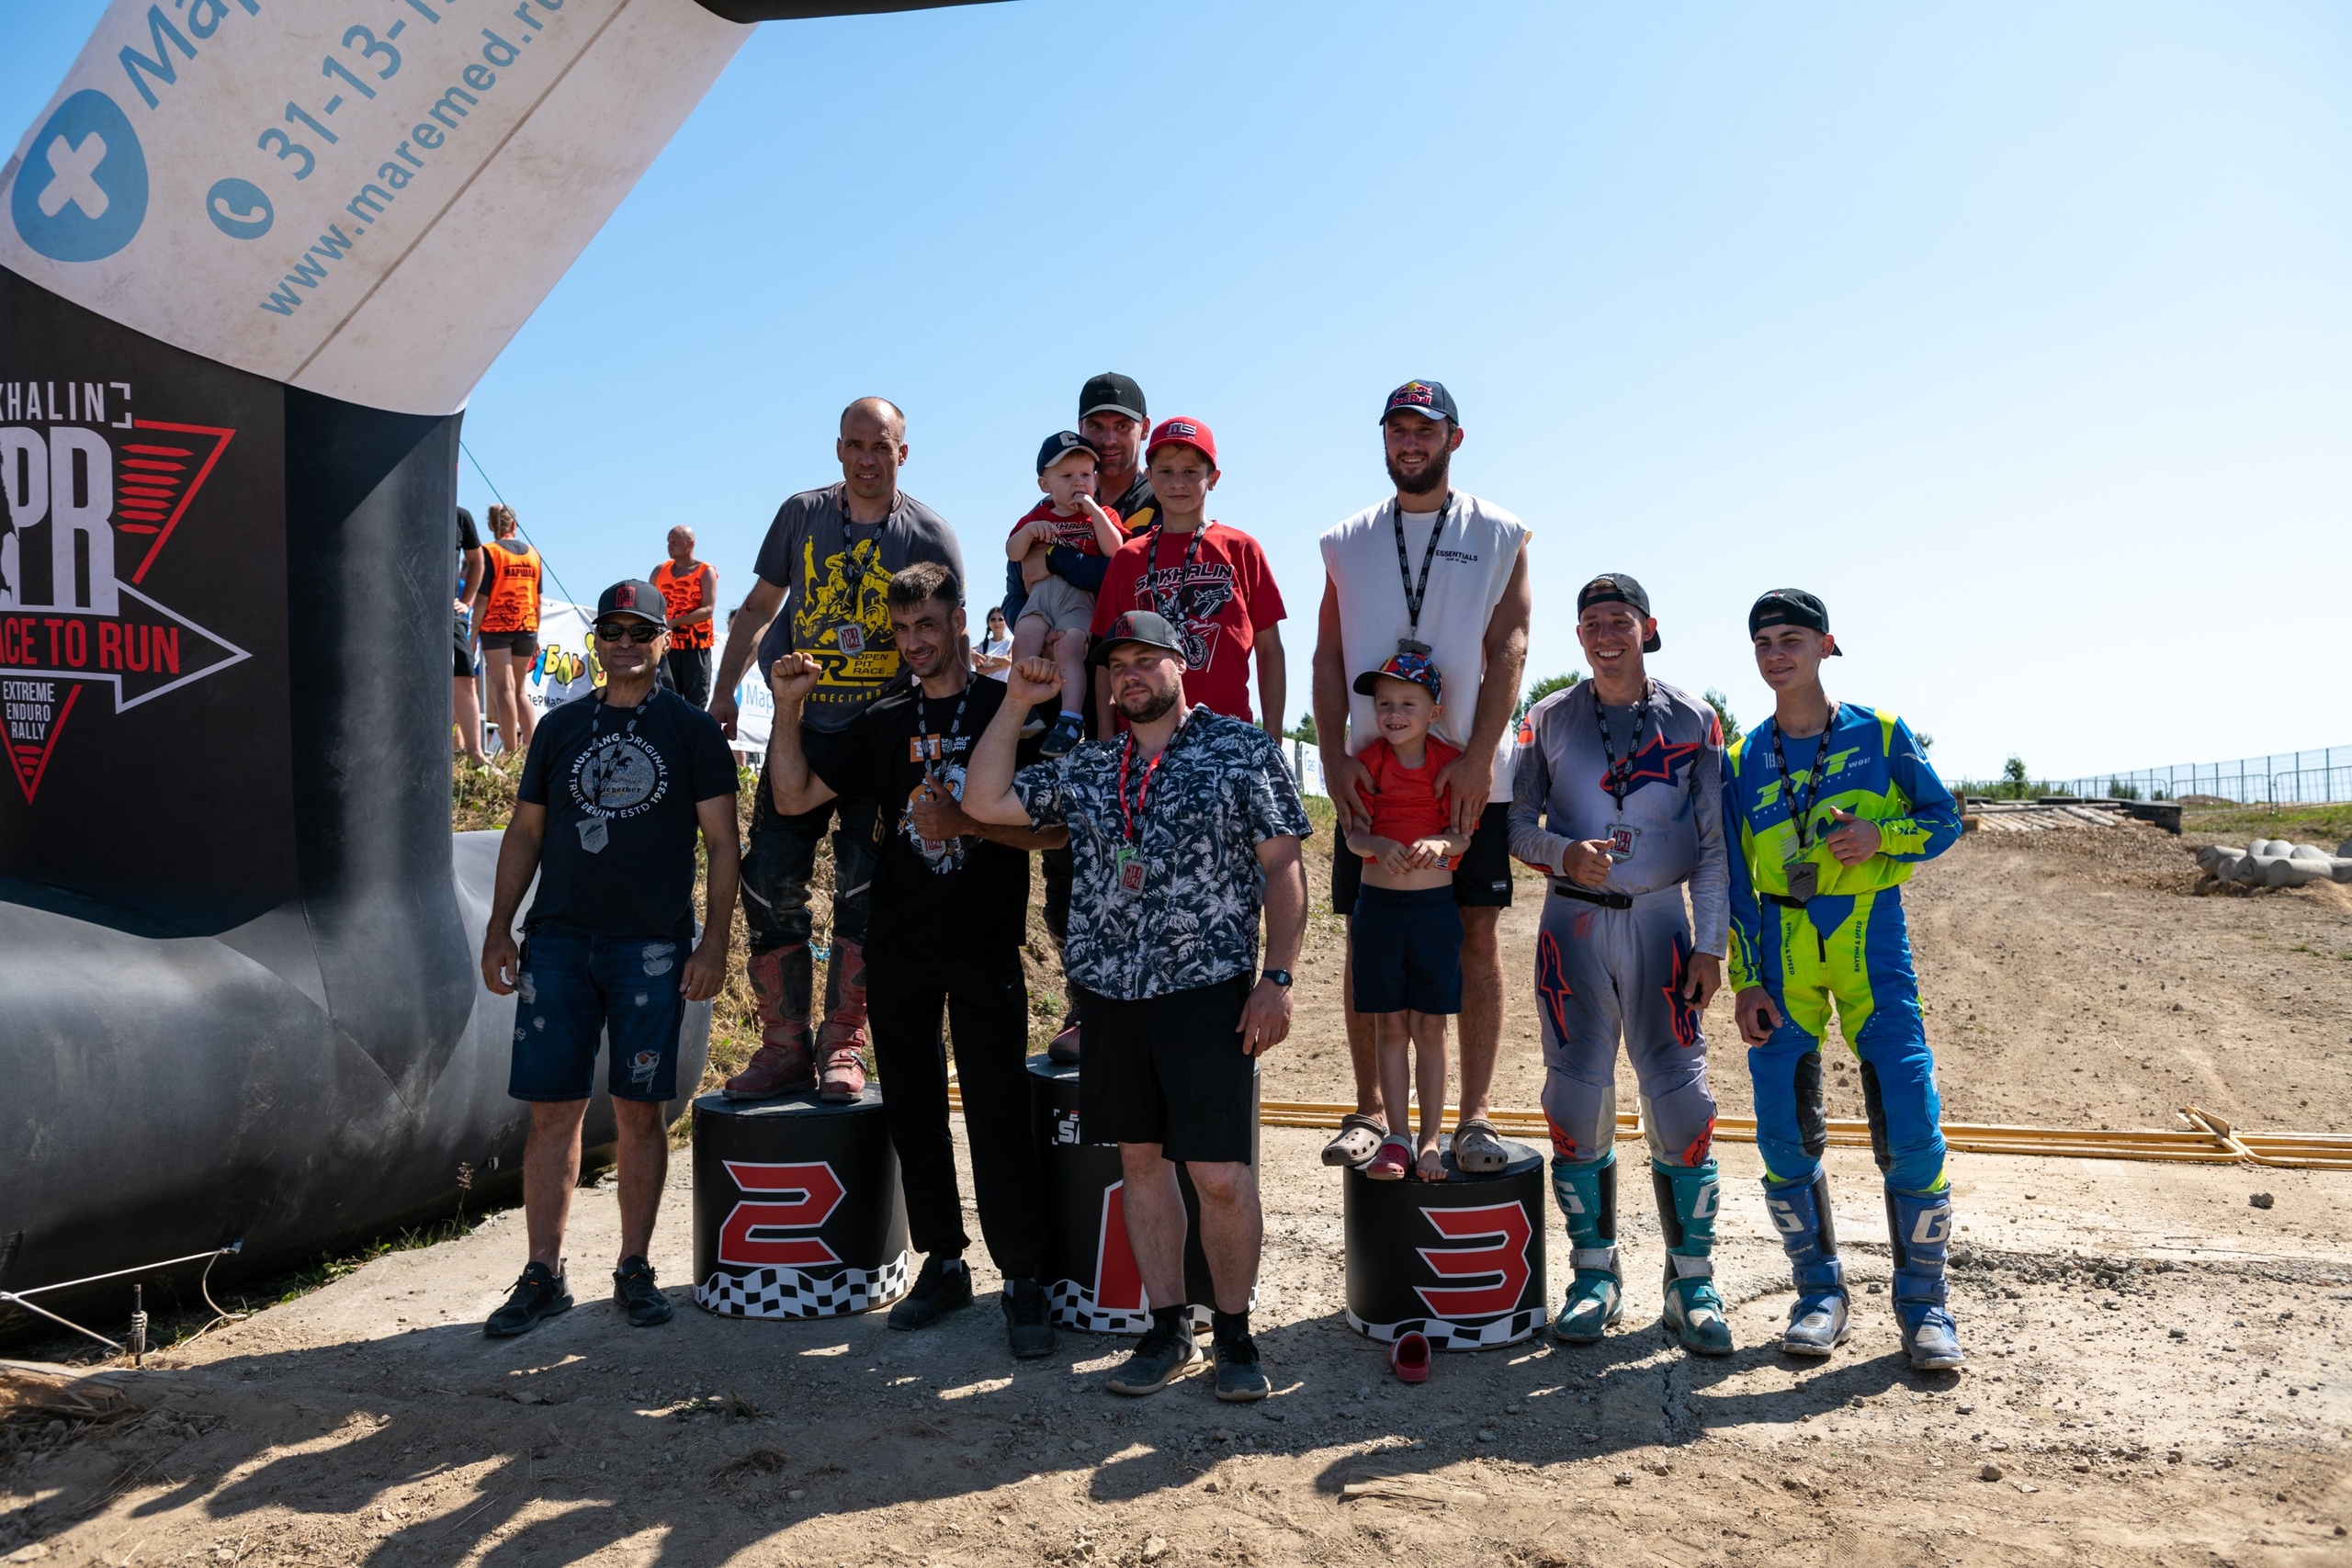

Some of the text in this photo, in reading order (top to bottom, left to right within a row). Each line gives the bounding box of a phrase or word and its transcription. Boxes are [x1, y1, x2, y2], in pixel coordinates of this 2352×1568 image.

[119, 0, 262, 110] Ма
[257, 0, 458, 181] 31-13-1
[1391, 393, 1432, 407] Red Bull
[1435, 549, 1478, 561] ESSENTIALS
[44, 618, 88, 668] TO
[97, 621, 180, 674] RUN
[3, 681, 55, 703] EXTREME
[6, 703, 51, 722] ENDURO
[11, 721, 46, 740] RALLY
[571, 732, 620, 774] MUSANG
[569, 777, 584, 804] TRUE
[650, 780, 669, 804] 1932
[581, 801, 650, 818] DENIM ESTD
[1854, 920, 1862, 942] SPEED
[1786, 954, 1795, 976] SPEED
[718, 1159, 848, 1269] 2
[1765, 1198, 1805, 1233] G
[1911, 1202, 1951, 1244] G
[1411, 1200, 1532, 1319] 3
